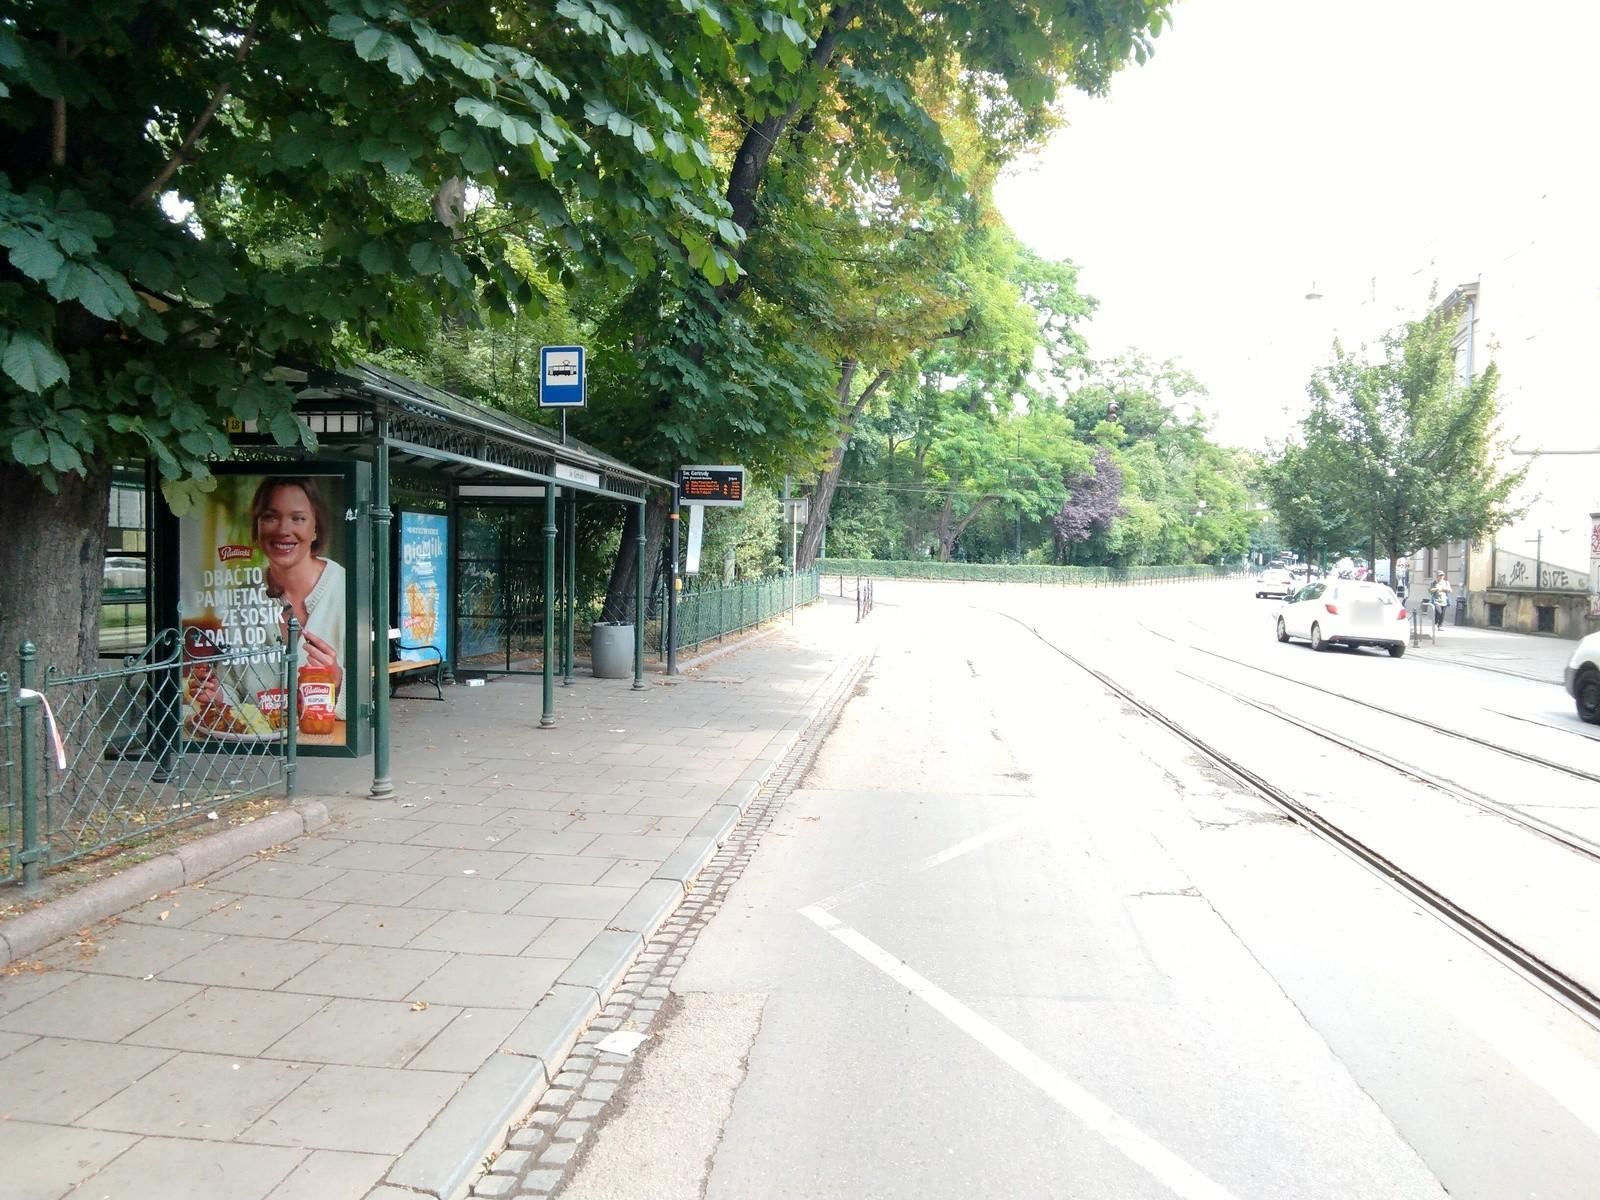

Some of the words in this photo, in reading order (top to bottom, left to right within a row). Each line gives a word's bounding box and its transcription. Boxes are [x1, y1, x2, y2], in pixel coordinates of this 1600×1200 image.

[203, 565, 242, 588] DBAĆ
[243, 566, 263, 586] TO
[195, 583, 273, 610] PAMIĘTAĆ,
[240, 606, 285, 626] SOSIK
[204, 628, 243, 648] DALA
[245, 626, 267, 645] OD
